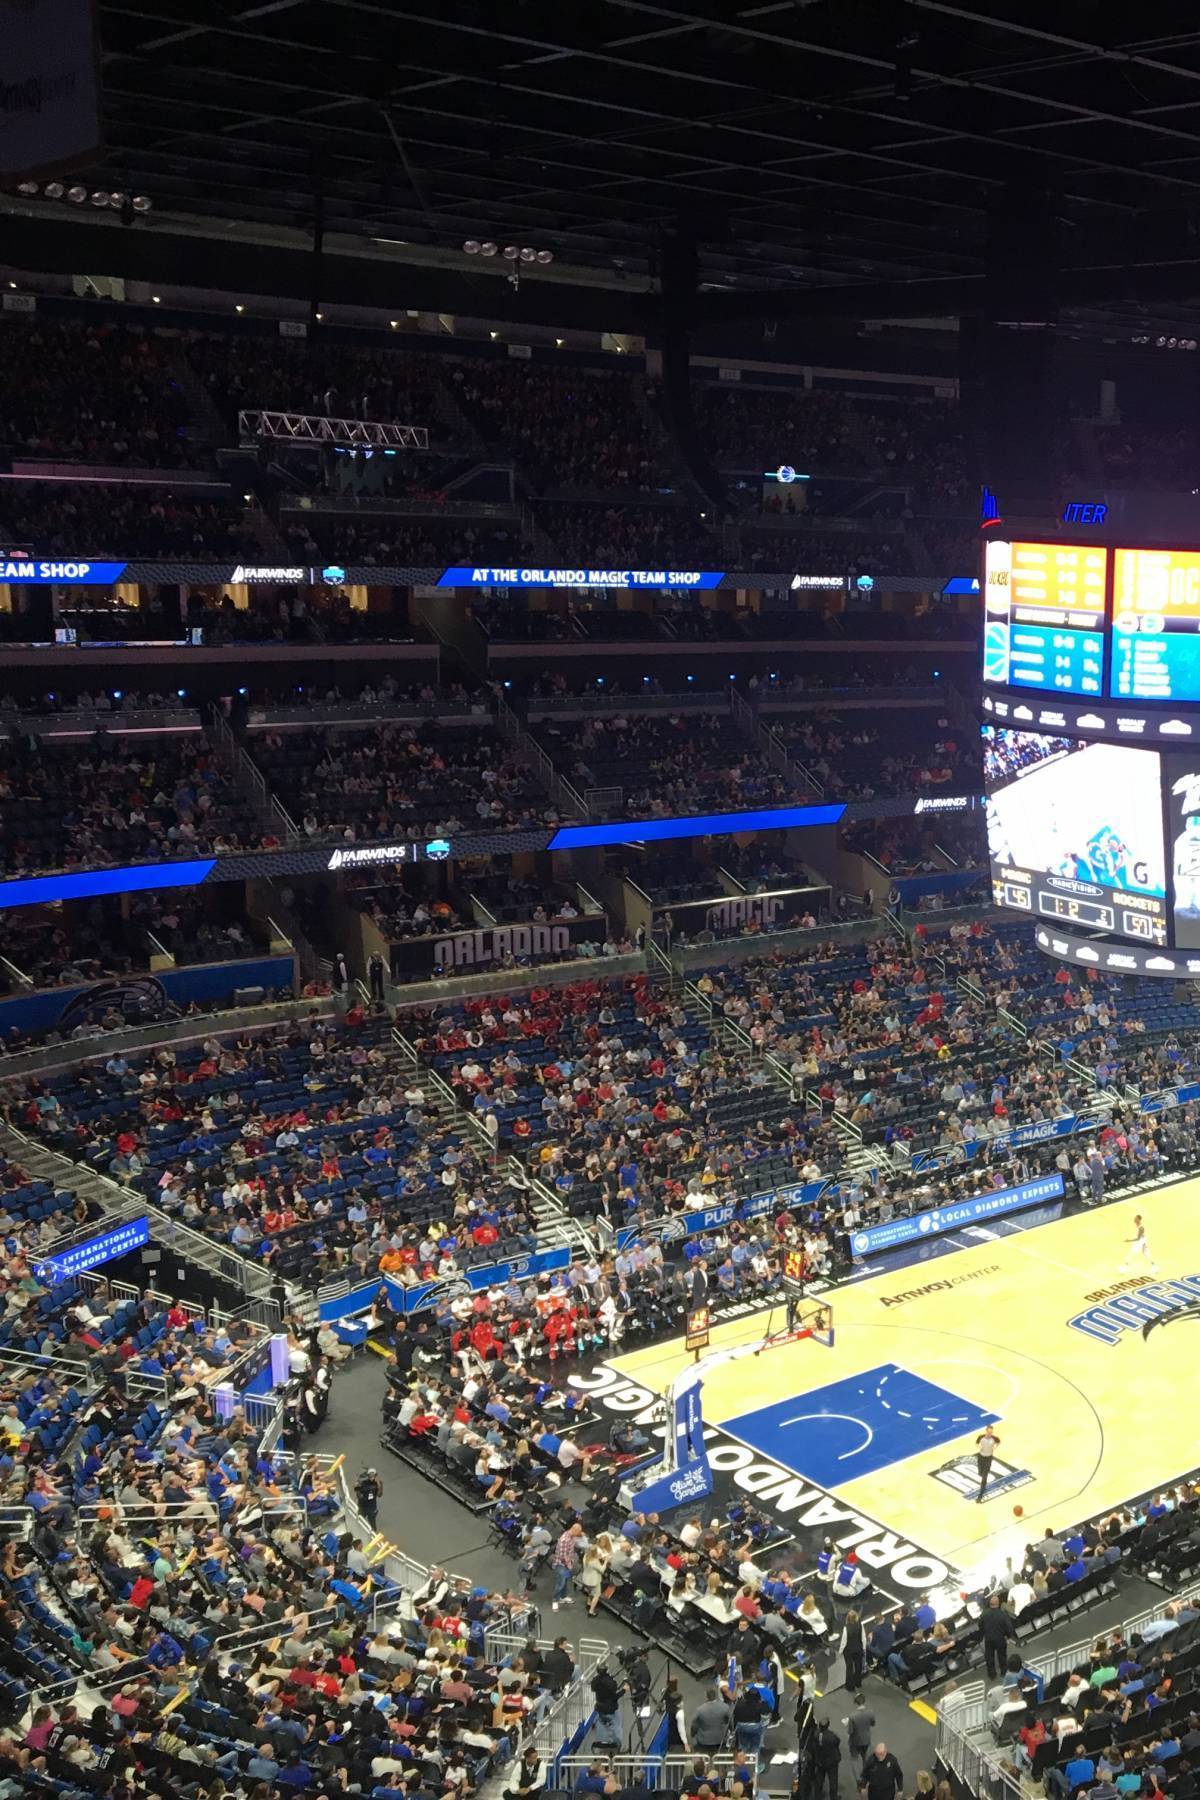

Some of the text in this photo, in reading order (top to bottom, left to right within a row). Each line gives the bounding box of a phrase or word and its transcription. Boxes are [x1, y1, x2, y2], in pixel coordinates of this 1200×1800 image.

[39, 563, 90, 578] SHOP
[244, 568, 303, 579] FAIRWINDS
[472, 568, 701, 585] AT THE ORLANDO MAGIC TEAM SHOP
[923, 797, 967, 809] FAIRWINDS
[342, 846, 406, 862] FAIRWINDS
[1001, 868, 1031, 884] MAGIC
[1113, 892, 1160, 913] ROCKETS
[434, 926, 569, 966] ORLANDO
[1023, 1123, 1058, 1142] MAGIC
[941, 1182, 1060, 1224] LOCAL DIAMOND EXPERTS
[704, 1208, 733, 1227] PUR
[63, 1228, 136, 1266] INTERNATIONAL
[111, 1234, 145, 1254] CENTER
[880, 1265, 1000, 1307] Amway CENTER
[1083, 1276, 1156, 1302] ORLANDO
[715, 1302, 754, 1319] YEARS
[670, 1477, 694, 1493] Olive
[674, 1482, 707, 1502] Garden
[707, 1445, 950, 1588] ORLANDO
